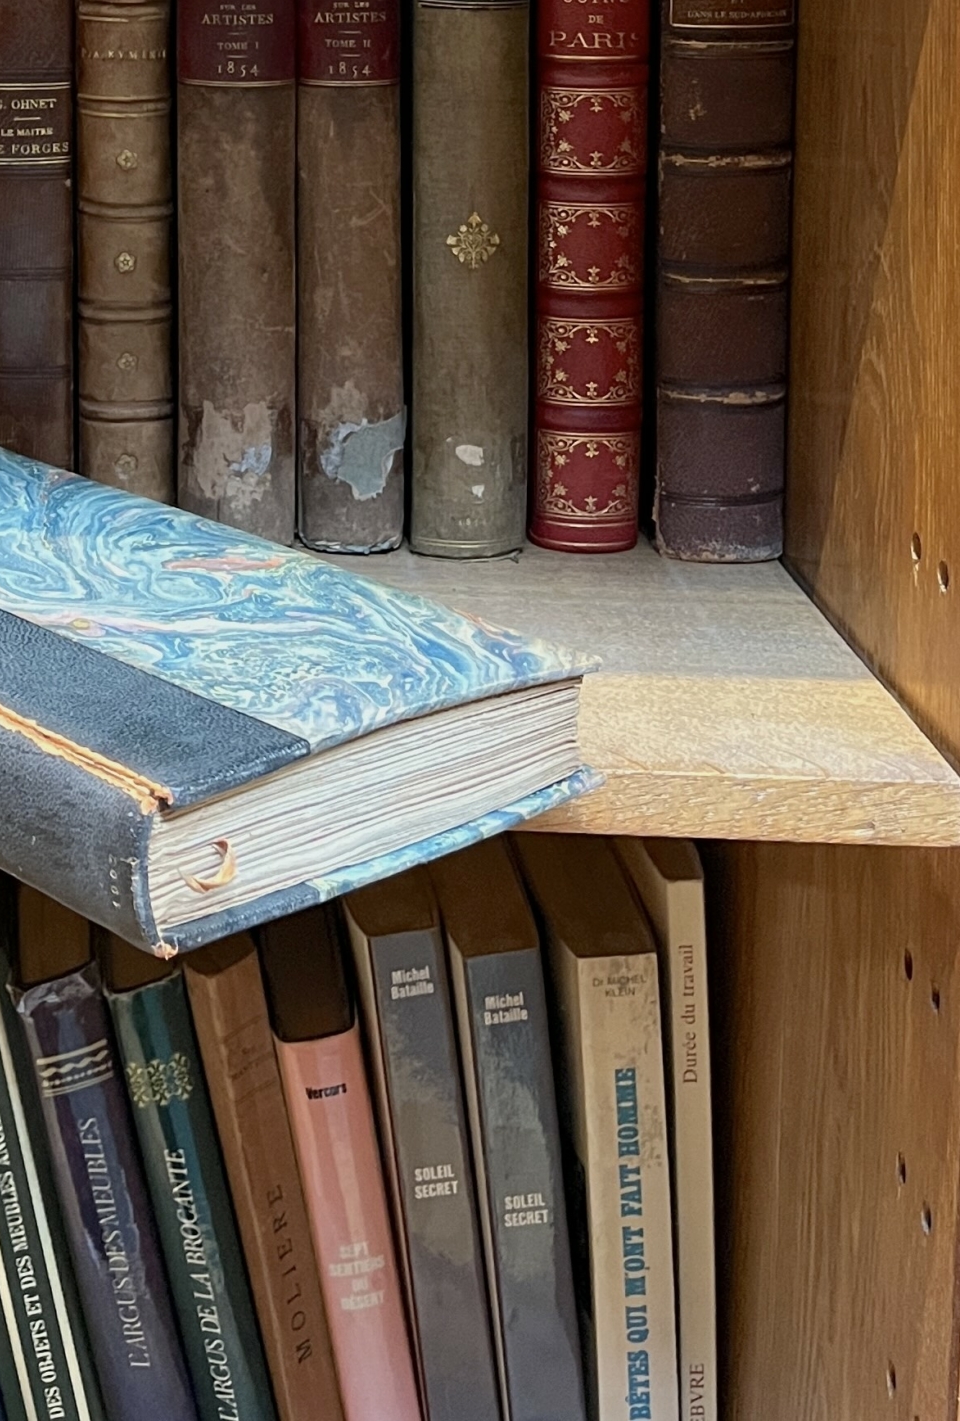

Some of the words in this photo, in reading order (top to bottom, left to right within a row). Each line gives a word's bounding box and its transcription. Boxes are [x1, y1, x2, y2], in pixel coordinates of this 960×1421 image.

[201, 13, 274, 26] ARTISTES
[314, 11, 386, 24] ARTISTES
[588, 14, 604, 25] DE
[325, 38, 356, 48] TOME
[217, 60, 260, 77] 1854
[329, 56, 372, 78] 1854
[11, 98, 57, 109] OHNET
[11, 142, 69, 155] FORGES
[391, 965, 430, 984] Michel
[678, 945, 694, 997] travail
[391, 980, 434, 1001] Bataille
[485, 991, 525, 1011] Michel
[605, 986, 635, 998] KLEIN
[484, 1006, 528, 1026] Bataille
[681, 1003, 696, 1024] du
[682, 1031, 699, 1084] Durée
[306, 1082, 347, 1101] Vercors
[615, 1067, 640, 1158] HOMME
[78, 1117, 119, 1227] MEUBLES
[414, 1164, 455, 1182] SOLEIL
[415, 1180, 459, 1200] SECRET
[618, 1163, 643, 1217] FAIT
[164, 1148, 208, 1265] BROCANTE
[504, 1192, 546, 1211] SOLEIL
[504, 1209, 549, 1228] SECRET
[103, 1230, 130, 1274] DES
[621, 1225, 648, 1298] M'ONT
[15, 1255, 41, 1290] DES
[190, 1272, 215, 1302] LA
[24, 1293, 42, 1316] ET
[113, 1276, 151, 1368] L'ARGUS
[193, 1305, 222, 1334] DE
[625, 1305, 649, 1344] QUI
[30, 1319, 57, 1383] OBJETS
[205, 1338, 239, 1421] L'ARGUS
[625, 1349, 652, 1421] BÊTES
[44, 1385, 65, 1420] DES
